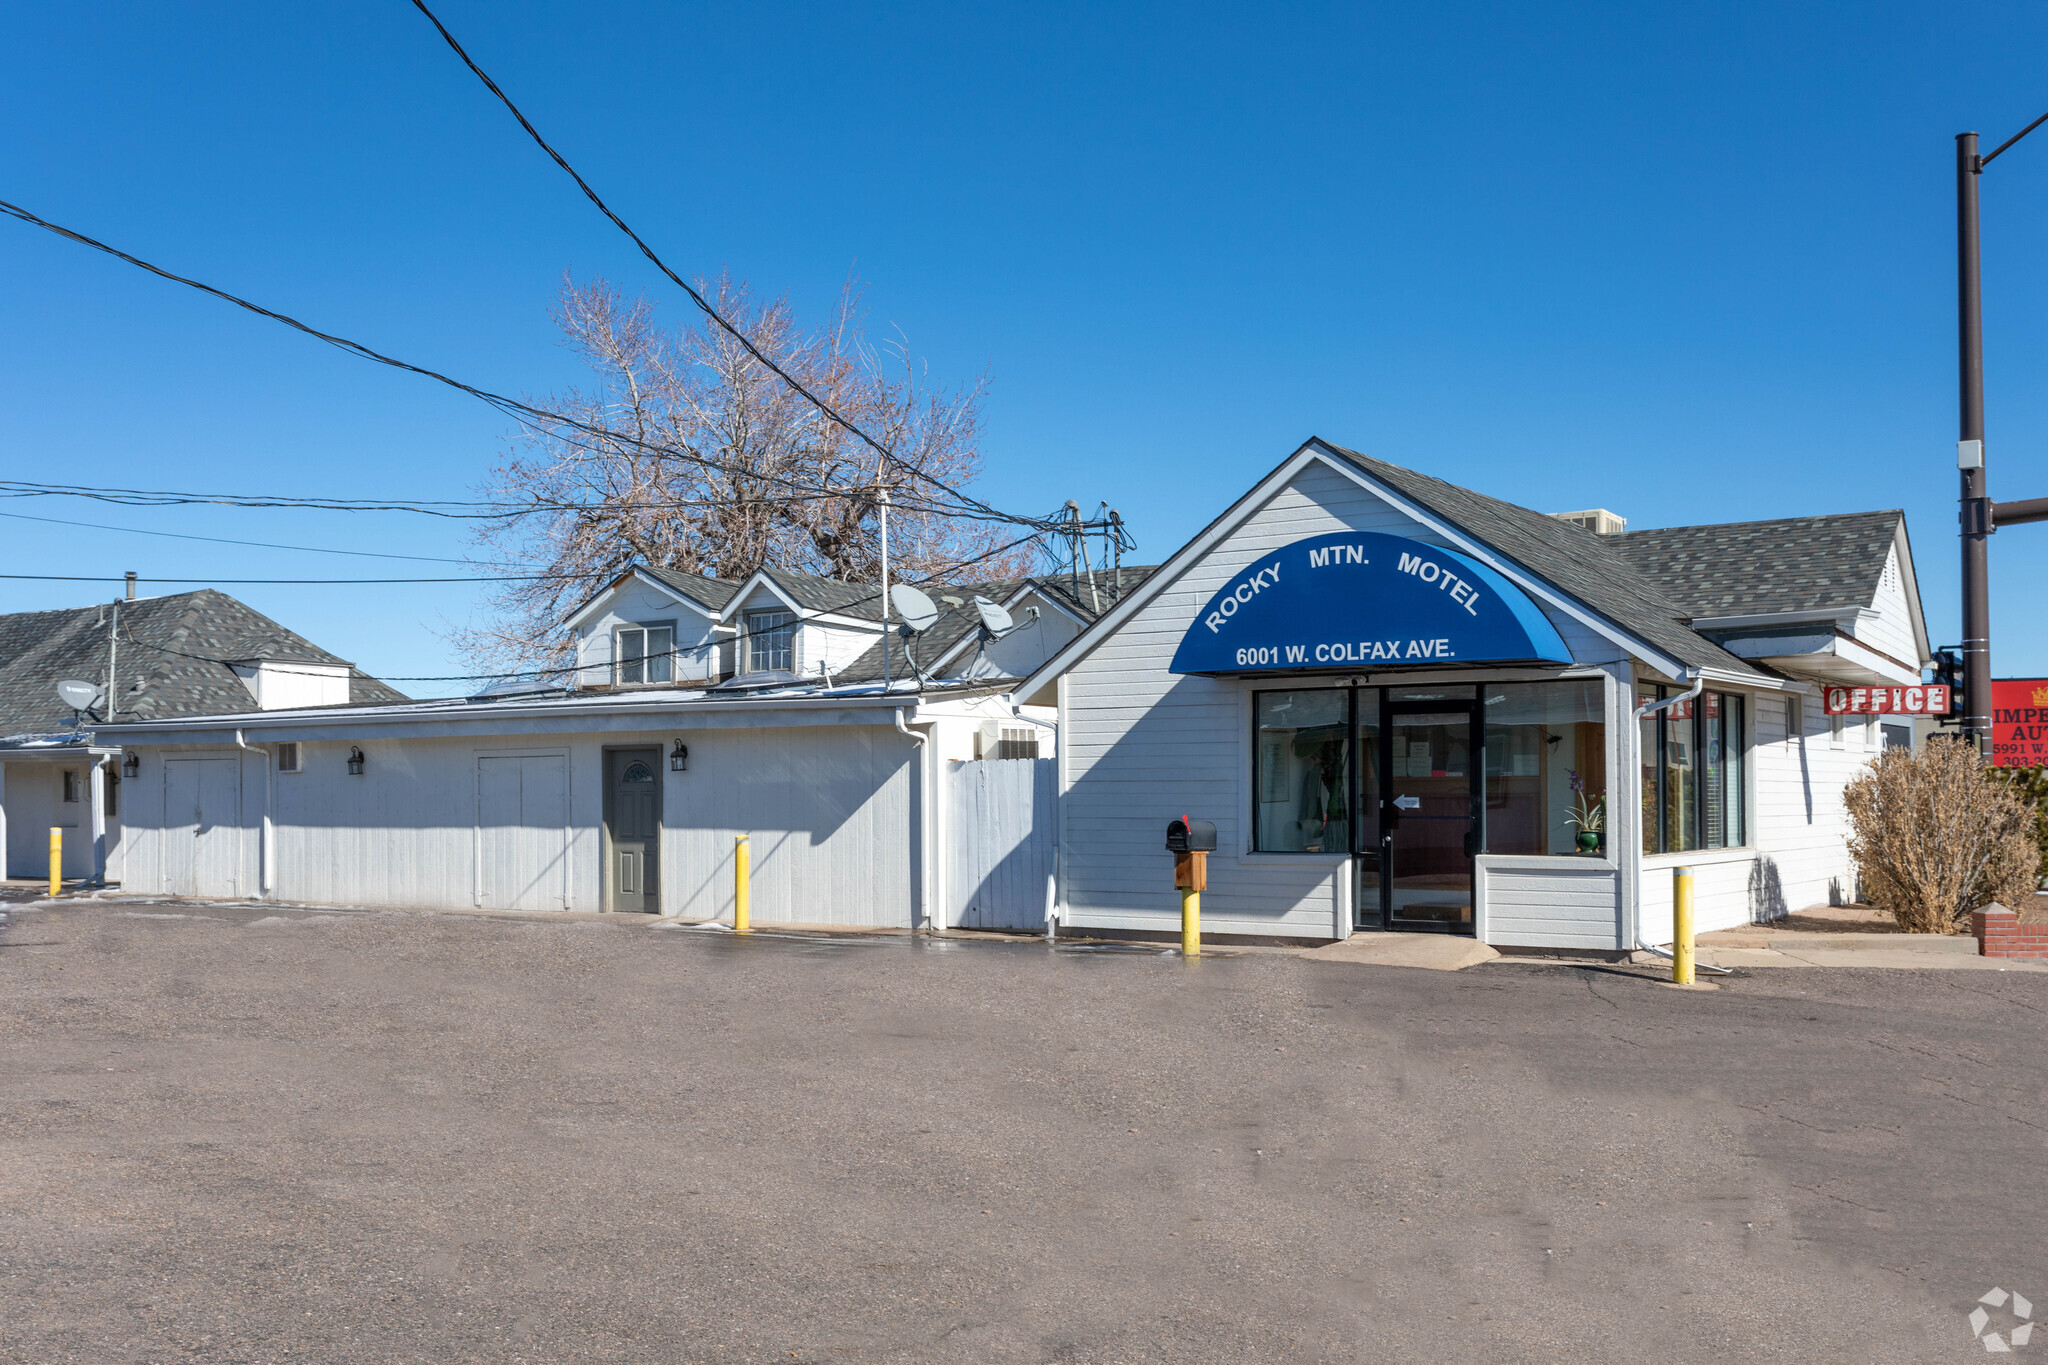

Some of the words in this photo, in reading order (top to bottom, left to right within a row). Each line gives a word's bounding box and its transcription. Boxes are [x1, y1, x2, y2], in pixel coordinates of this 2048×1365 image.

[1204, 561, 1281, 634] ROCKY
[1309, 545, 1369, 569] MTN.
[1397, 551, 1480, 617] MOTEL
[1236, 646, 1278, 666] 6001
[1285, 645, 1310, 664] W.
[1315, 640, 1401, 662] COLFAX
[1405, 638, 1456, 660] AVE.
[1829, 687, 1944, 711] OFFICE
[1993, 743, 2026, 754] 5991
[2031, 743, 2048, 754] W.
